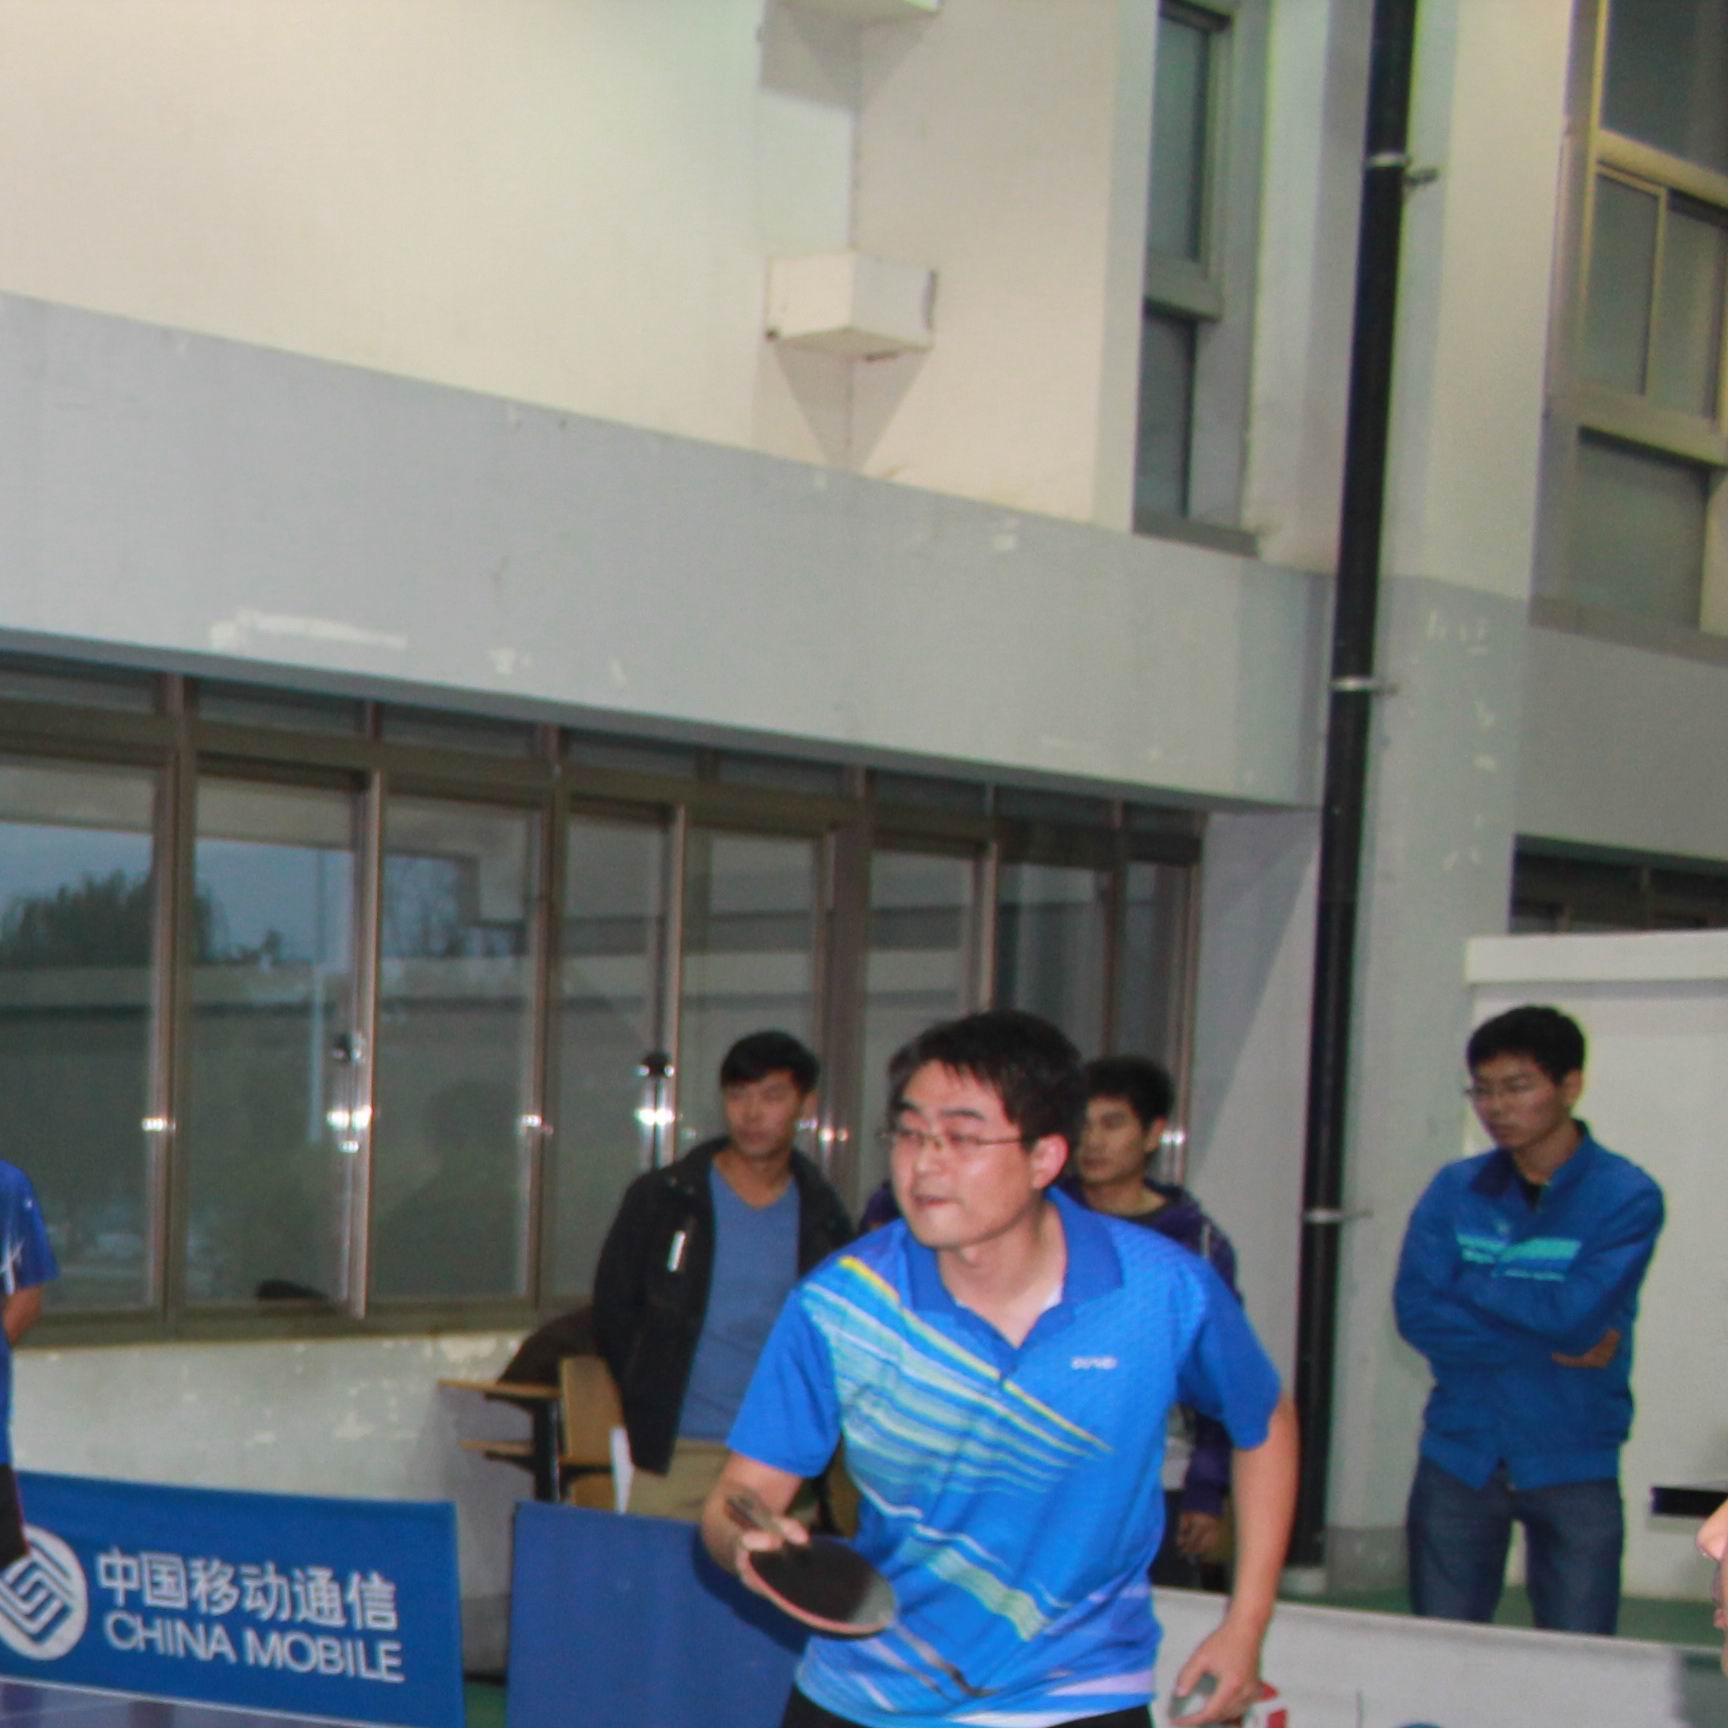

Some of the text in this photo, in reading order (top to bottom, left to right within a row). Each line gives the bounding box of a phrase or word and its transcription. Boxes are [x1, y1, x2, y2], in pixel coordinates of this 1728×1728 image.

[96, 1547, 399, 1633] 中国移动通信
[104, 1611, 404, 1684] CHINA MOBILE
